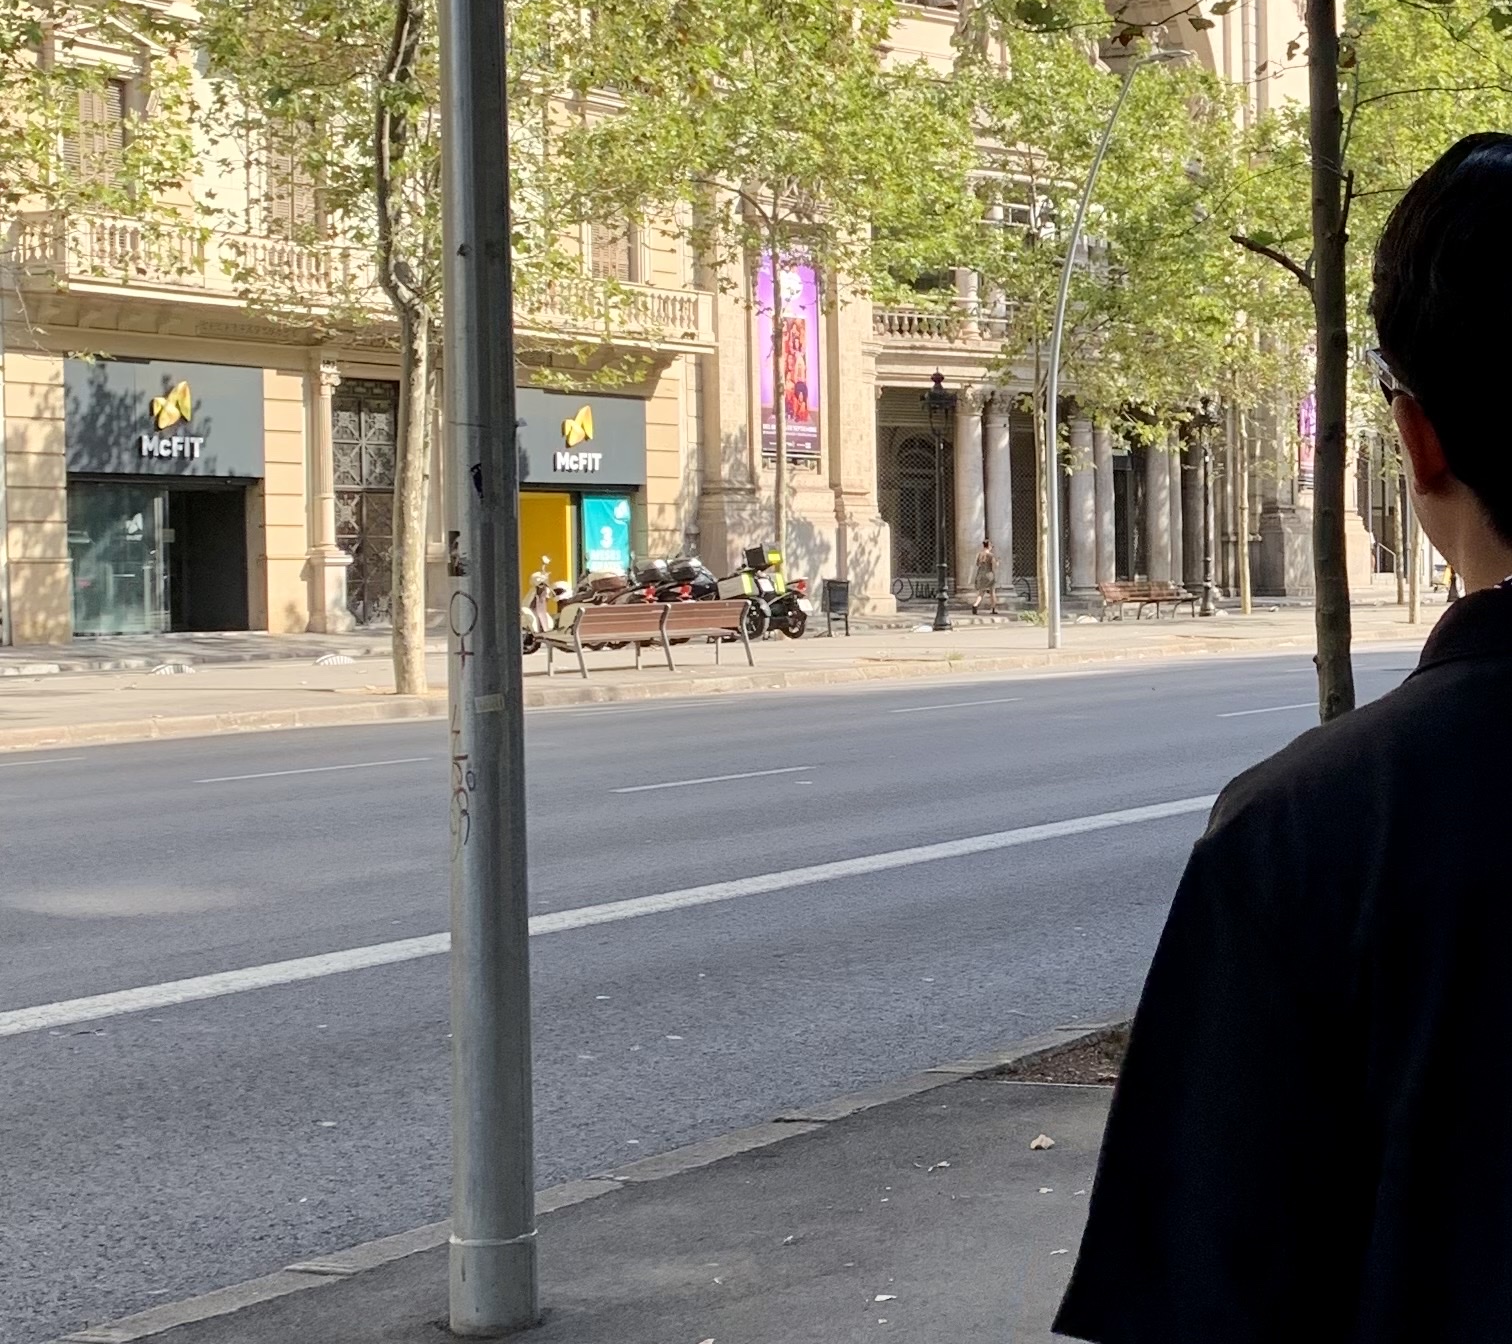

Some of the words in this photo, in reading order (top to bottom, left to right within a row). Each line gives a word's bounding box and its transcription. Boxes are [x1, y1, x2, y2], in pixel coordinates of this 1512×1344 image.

[140, 434, 204, 458] McFIT
[555, 451, 603, 471] McFIT
[600, 525, 614, 549] 3
